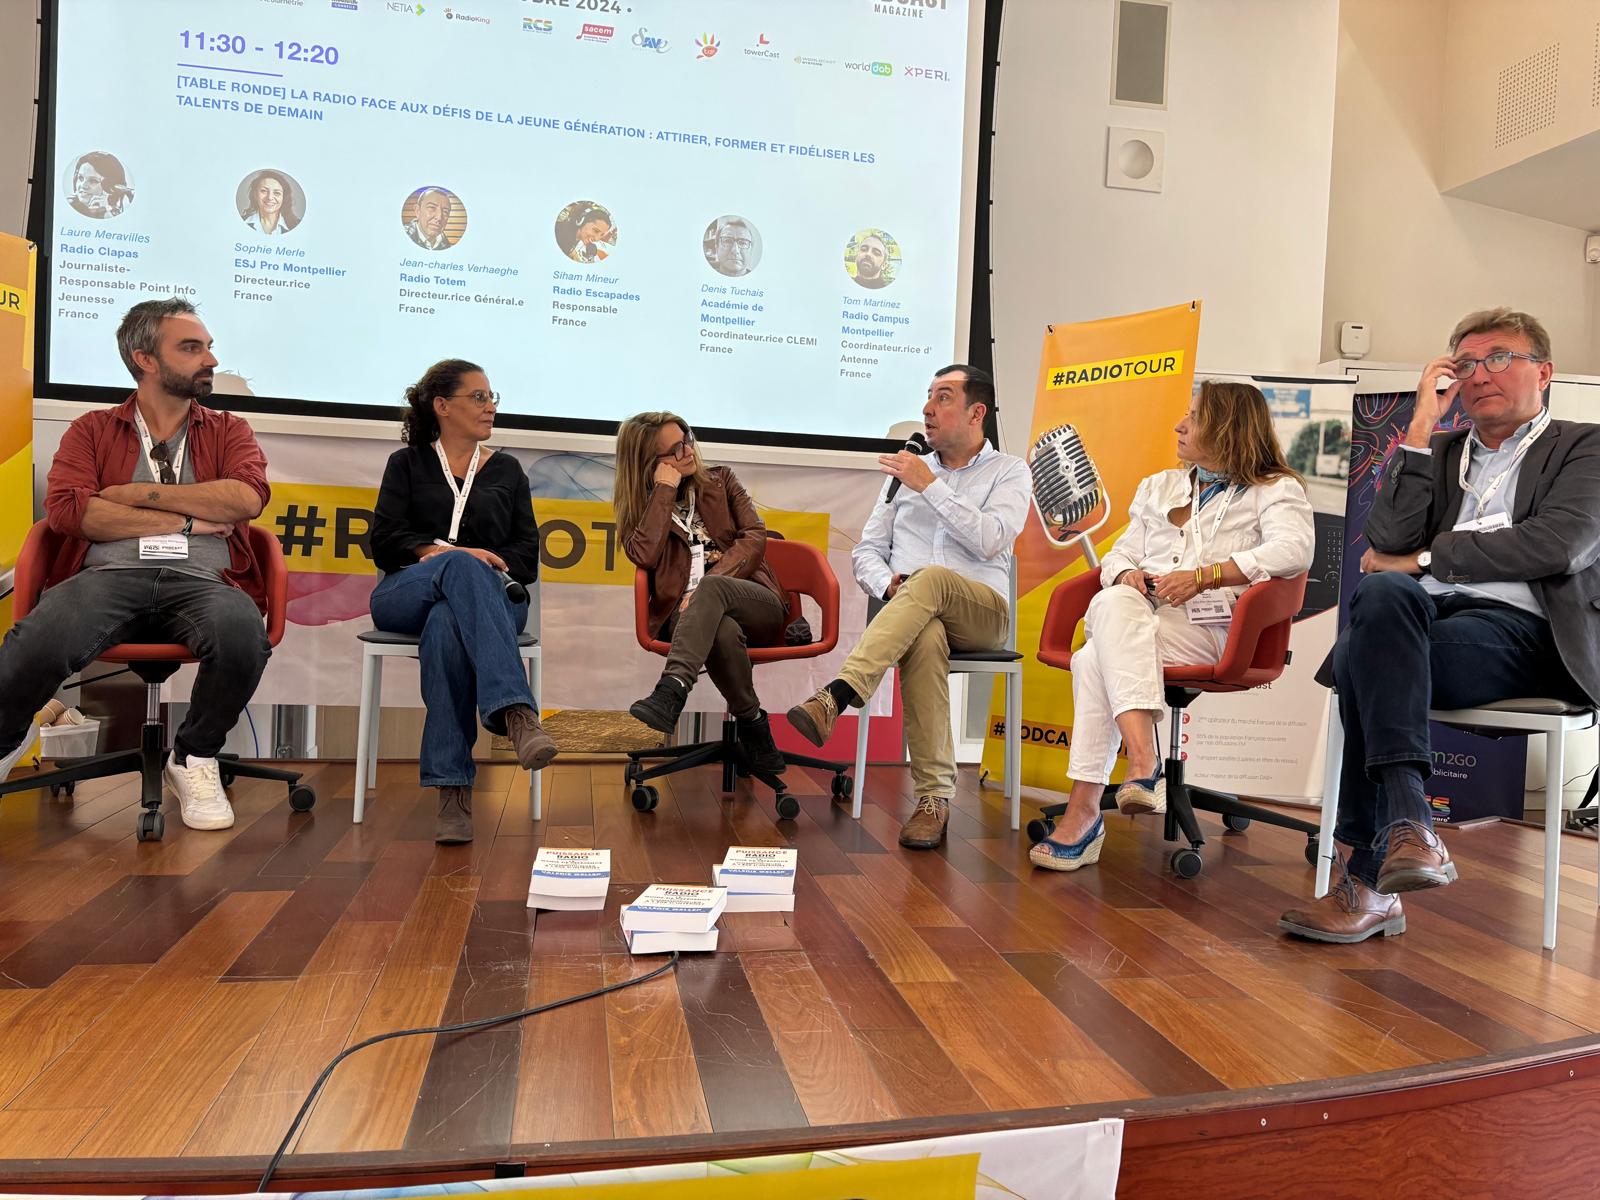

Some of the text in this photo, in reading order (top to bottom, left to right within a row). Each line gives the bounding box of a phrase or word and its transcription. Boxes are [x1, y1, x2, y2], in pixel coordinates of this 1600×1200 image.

[386, 2, 414, 14] NETIA
[874, 3, 924, 19] MAGAZINE
[455, 13, 491, 25] RadioKing
[522, 17, 553, 32] RCS
[583, 24, 613, 35] sacem
[179, 30, 247, 55] 11:30
[274, 41, 340, 66] 12:20
[176, 95, 324, 121] TALENTS DE DEMAIN
[176, 75, 227, 92] [TABLE
[231, 82, 287, 100] RONDE]
[290, 88, 308, 100] LA
[312, 90, 357, 107] RADIO
[361, 97, 397, 111] FACE
[400, 102, 429, 115] AUX
[432, 103, 472, 120] DÉFIS
[475, 110, 493, 122] DE
[497, 113, 514, 125] LA
[517, 115, 560, 130] JEUNE
[563, 117, 646, 140] GÉNÉRATION
[656, 129, 712, 148] ATTIRER,
[714, 136, 767, 153] FORMER
[770, 142, 786, 155] ET
[789, 143, 850, 161] FIDÉLISER
[853, 151, 876, 164] LES
[60, 226, 151, 244] Laure Meravilles
[60, 244, 139, 262] Radio Clapas
[234, 242, 306, 258] Sophie Merle
[59, 260, 131, 275] Journaliste-
[234, 259, 347, 278] ESJ Pro Montpellier
[399, 258, 519, 278] Jean-charles Verhaeghe
[59, 276, 197, 296] Responsable Point Info
[234, 274, 311, 290] Directeur.rice
[399, 273, 467, 287] Radio Totem
[552, 271, 620, 286] Siham Mineur
[58, 293, 115, 305] Jeunesse
[233, 290, 273, 303] France
[398, 288, 525, 307] Directeur.rice Général.e
[552, 286, 641, 303] Radio Escapades
[701, 284, 765, 299] Denis Tuchais
[398, 304, 436, 316] France
[552, 301, 619, 315] Responsable
[701, 299, 764, 313] Académie de
[843, 296, 901, 310] Tom Martinez
[58, 309, 100, 321] France
[551, 316, 587, 328] France
[700, 313, 756, 327] Montpellier
[842, 311, 910, 326] Radio Campus
[700, 329, 818, 347] Coordinateur.rice CLEMI
[841, 326, 895, 339] Montpellier
[699, 343, 733, 355] France
[841, 340, 921, 354] Coordinateur.rice
[840, 355, 879, 366] Antenne
[840, 369, 872, 380] France
[1052, 357, 1176, 387] #RADIOTOUR
[1432, 768, 1468, 780] blicitaire
